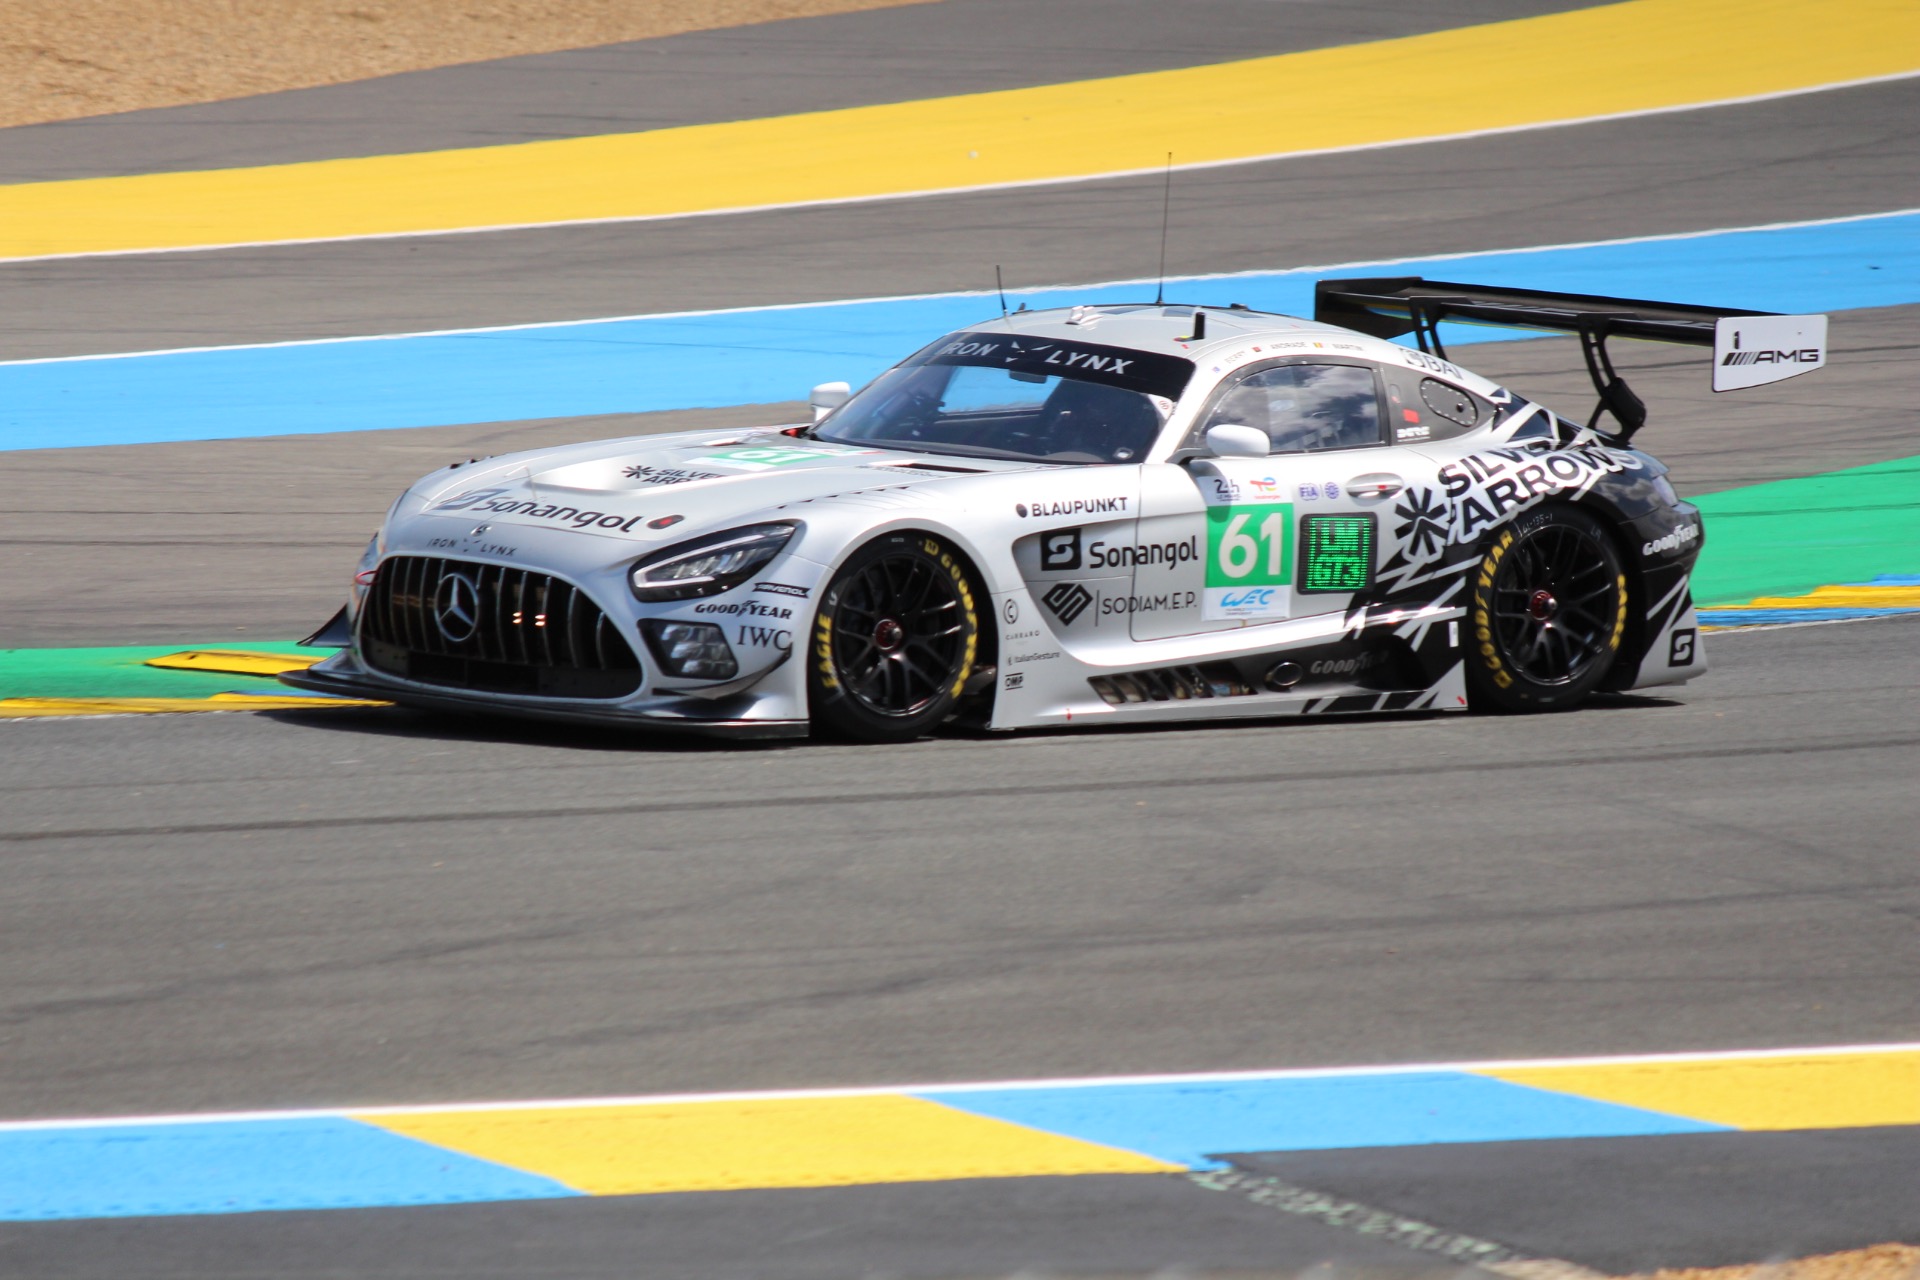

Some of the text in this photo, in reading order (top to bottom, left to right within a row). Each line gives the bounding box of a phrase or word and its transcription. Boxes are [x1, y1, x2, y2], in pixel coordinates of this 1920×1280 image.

[935, 342, 1134, 375] IRON LYNX
[1753, 348, 1820, 365] AMG
[728, 450, 822, 463] 61
[470, 496, 643, 533] Sonangol
[1032, 497, 1127, 517] BLAUPUNKT
[426, 538, 517, 557] IRON LYNX
[1089, 535, 1198, 571] Sonangol
[1218, 512, 1282, 578] 61
[1102, 592, 1198, 615] SODIAM.E.P.
[1220, 589, 1275, 607] WEC
[737, 626, 792, 650] IWC
[817, 613, 838, 688] EAGLE
